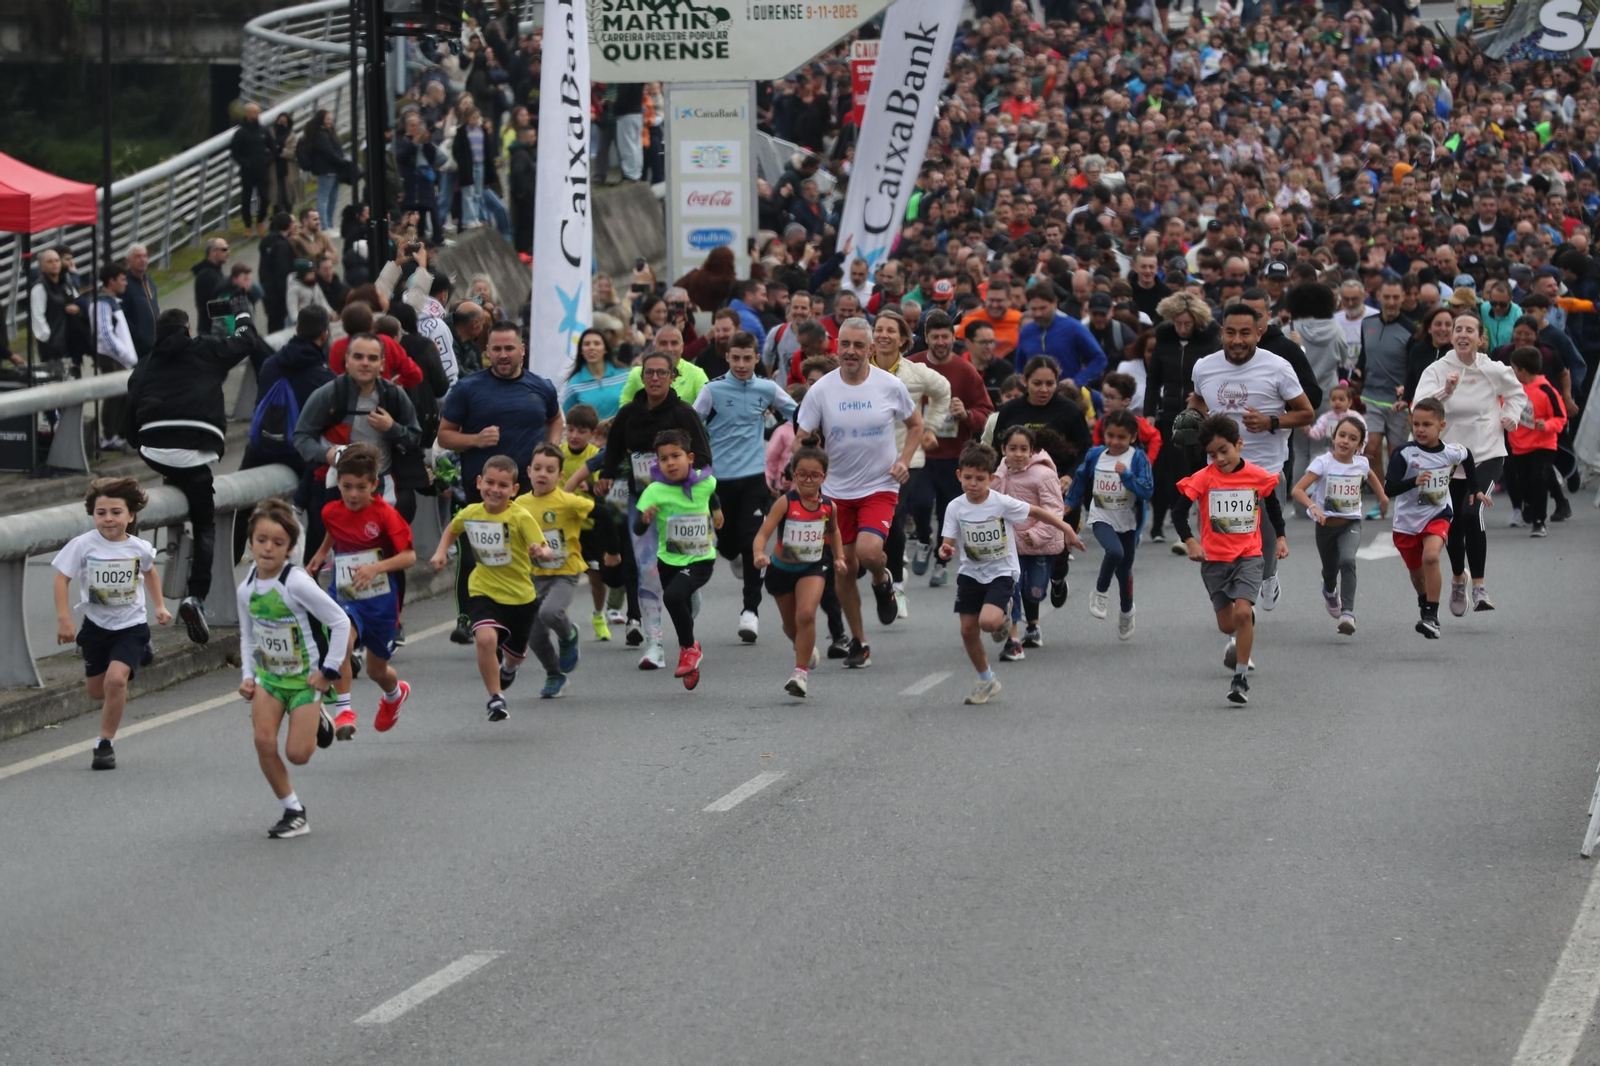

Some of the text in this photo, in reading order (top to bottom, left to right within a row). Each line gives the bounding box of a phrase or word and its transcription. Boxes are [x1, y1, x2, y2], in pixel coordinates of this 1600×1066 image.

[753, 4, 803, 20] OURENSE
[806, 4, 858, 20] 9-11-2025
[602, 13, 712, 31] MARTIN
[602, 31, 728, 42] CARREIRA PEDESTRE POPULAR
[603, 41, 729, 61] OURENSE
[694, 107, 739, 118] CaixaBank
[558, 0, 588, 268] CaixaBan
[862, 22, 940, 235] CaixaBank
[1096, 480, 1123, 492] 10661
[1216, 500, 1253, 513] 11916
[674, 524, 706, 537] 10870
[790, 530, 822, 542] 11334
[966, 529, 1000, 543] 10030
[470, 531, 501, 545] 11869
[95, 570, 133, 584] 10029
